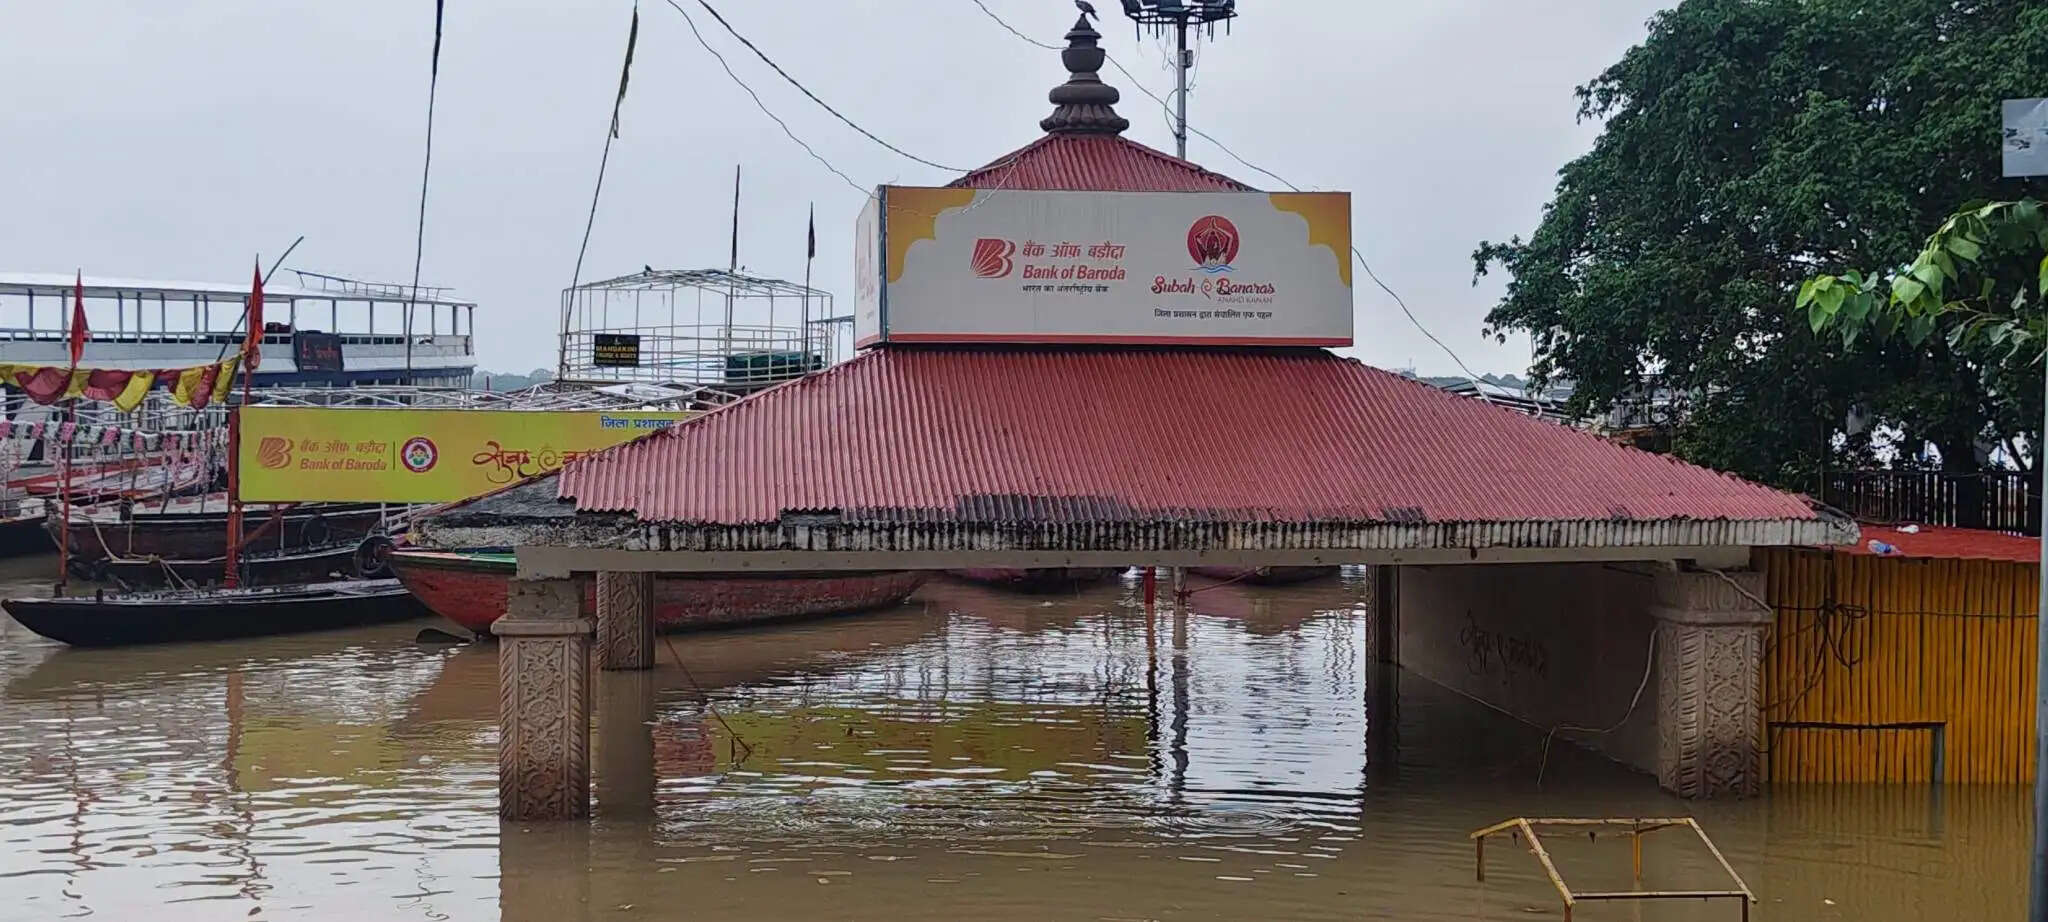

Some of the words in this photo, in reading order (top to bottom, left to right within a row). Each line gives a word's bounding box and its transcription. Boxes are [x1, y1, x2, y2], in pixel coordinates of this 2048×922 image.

[1022, 240, 1045, 257] बैंक
[1023, 265, 1057, 279] Bank
[1061, 264, 1076, 279] of
[1077, 265, 1125, 280] Baroda
[1151, 275, 1195, 294] Subah
[1215, 277, 1275, 295] Banaras
[600, 415, 628, 428] जिला
[300, 459, 329, 471] Bank
[332, 458, 344, 471] of
[345, 459, 386, 471] Baroda
